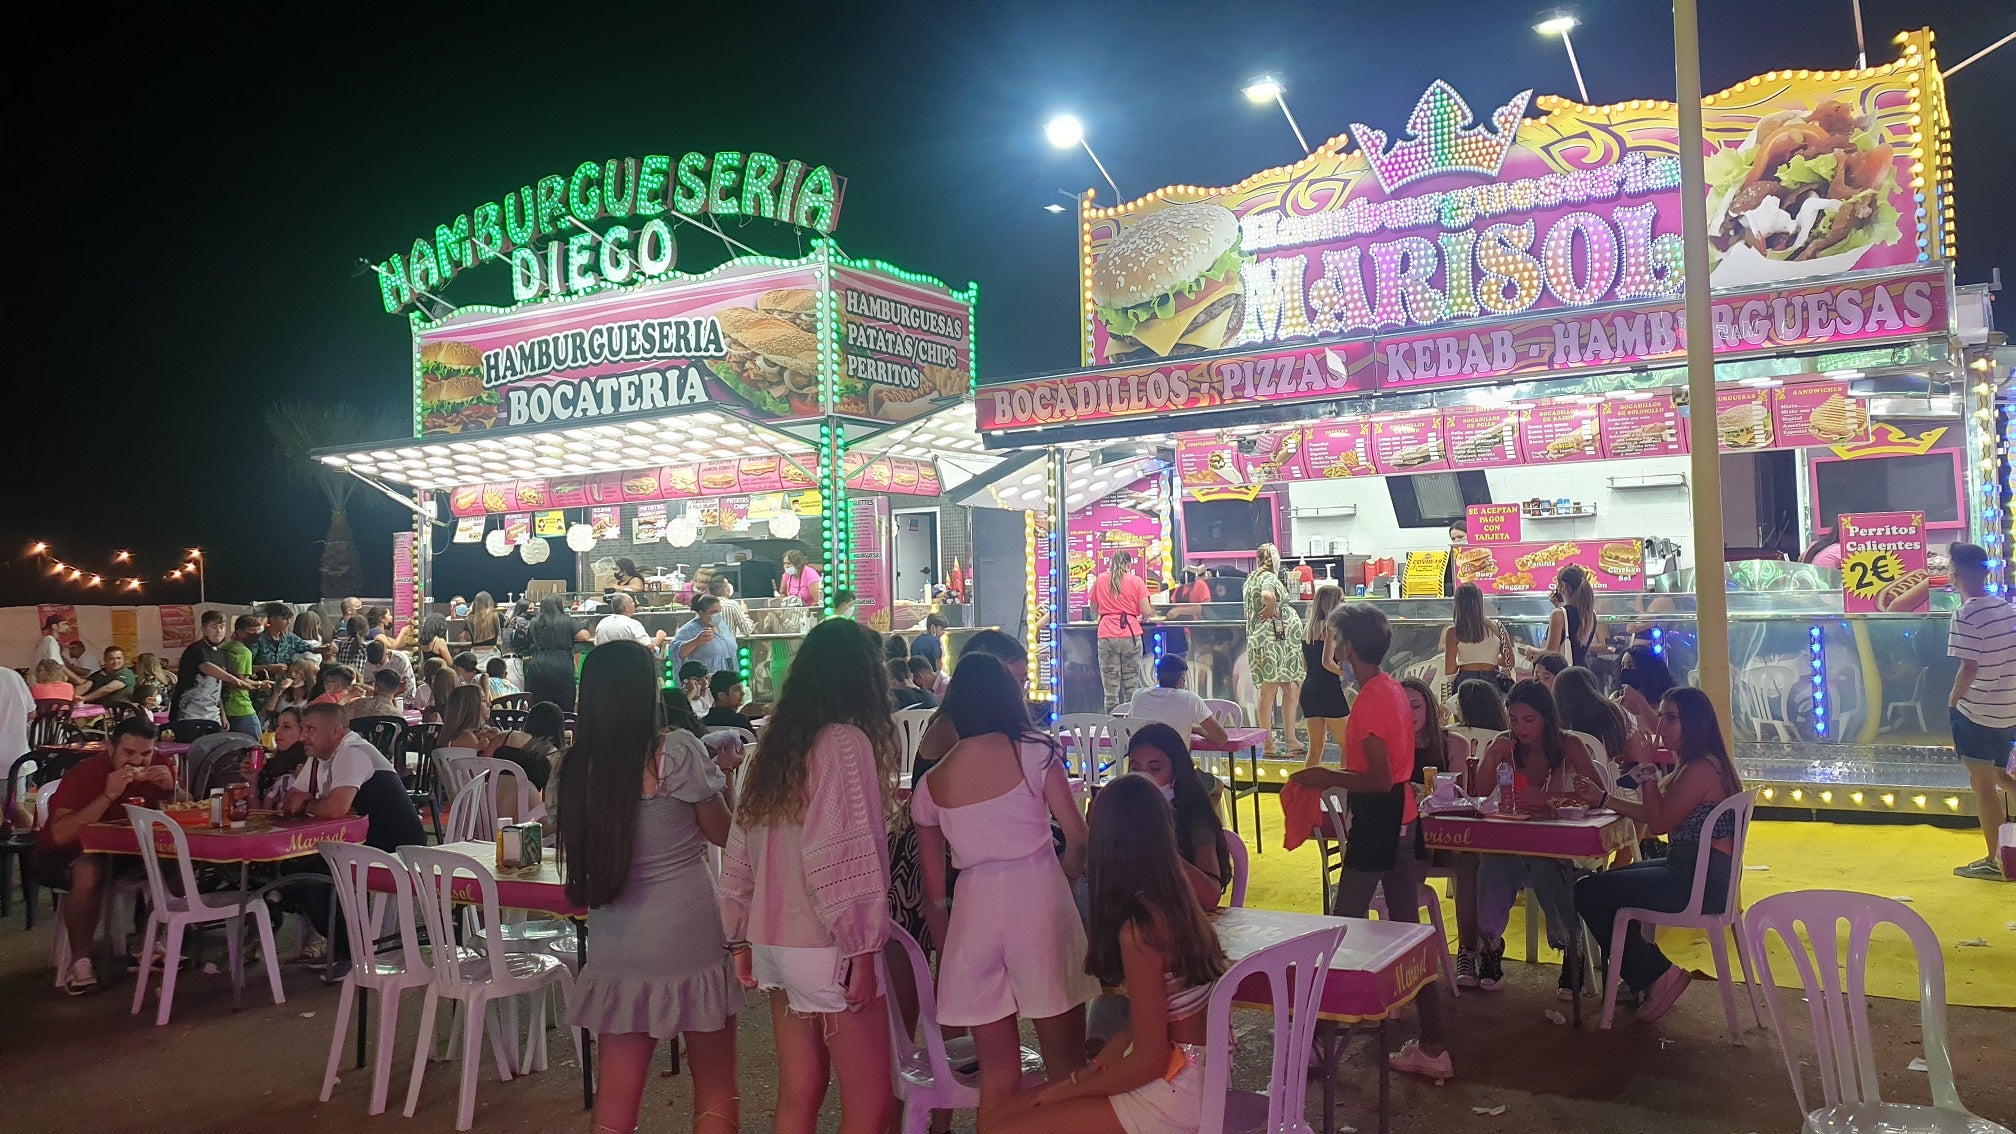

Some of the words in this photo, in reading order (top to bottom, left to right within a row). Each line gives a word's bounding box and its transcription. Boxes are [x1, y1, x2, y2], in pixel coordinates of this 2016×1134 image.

[378, 151, 836, 314] HAMBURGUESERIA
[511, 219, 675, 301] DIEGO
[1238, 200, 1686, 347] MARISOL
[846, 290, 964, 341] HAMBURGUESAS
[483, 316, 727, 386] HAMBURGUESERIA
[846, 322, 958, 369] PATATAS/CHIPS
[1386, 329, 1518, 383] KEBAB
[846, 355, 922, 389] PERRITOS
[993, 368, 1190, 425] BOCADILLOS
[1218, 349, 1350, 400] PIZZAS
[1793, 387, 1842, 396] SANDWICHES
[508, 366, 709, 426] BOCATERIA
[1718, 394, 1755, 402] URGUESAS
[1481, 506, 1518, 515] ACEPTAN
[1849, 524, 1917, 538] Perritos
[1474, 533, 1510, 541] TARJETA
[1846, 540, 1922, 552] Calientes
[1850, 554, 1895, 590] 2€
[285, 825, 348, 852] Marisol
[1424, 828, 1473, 846] arisol
[1393, 945, 1428, 997] Marisol
